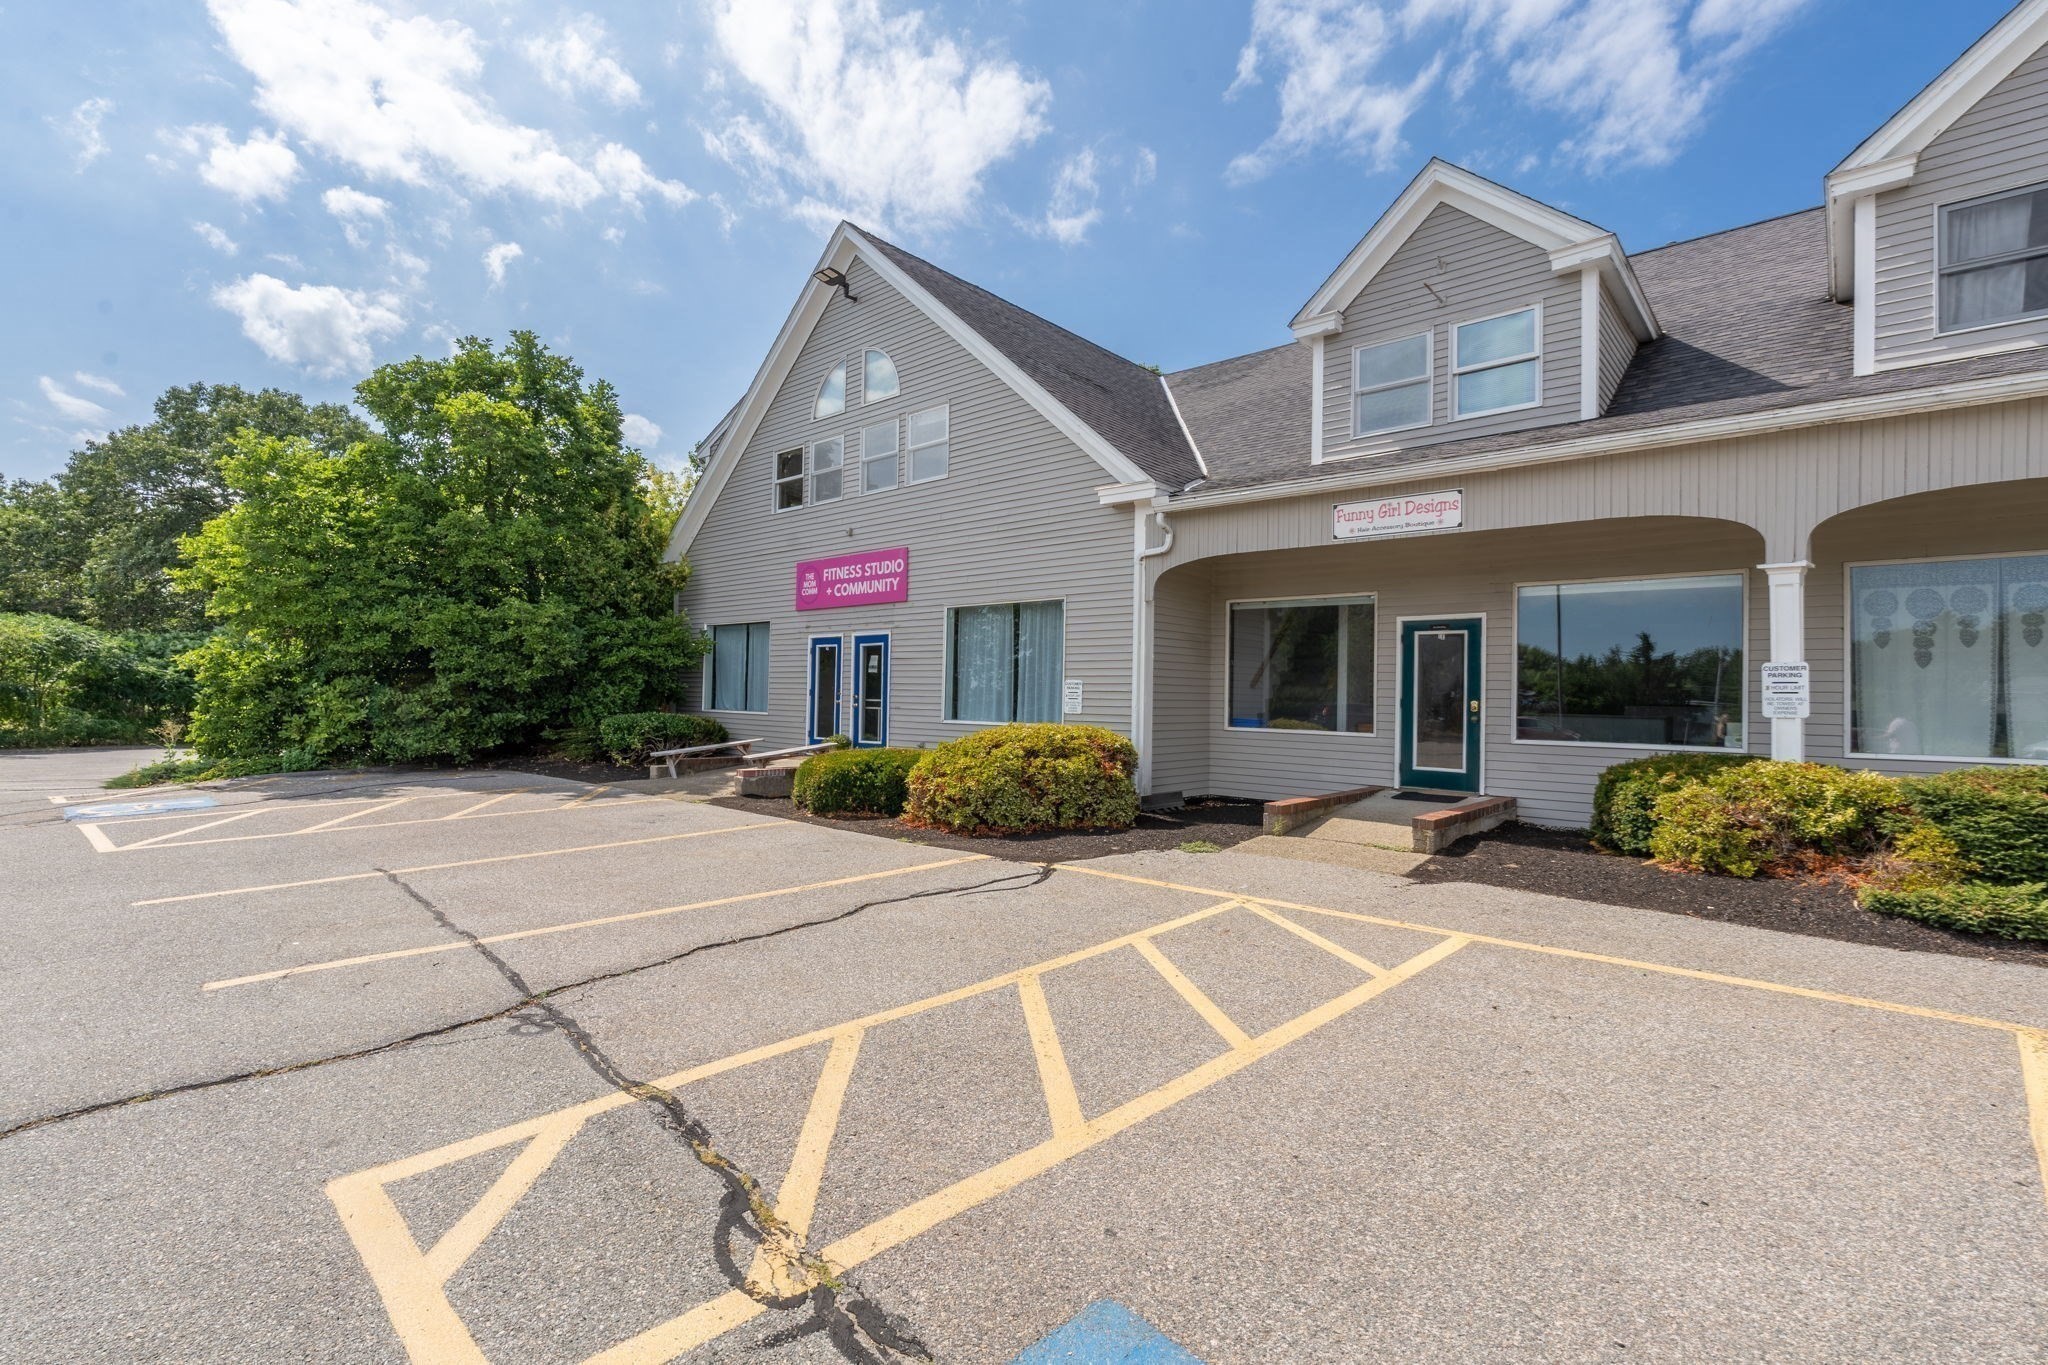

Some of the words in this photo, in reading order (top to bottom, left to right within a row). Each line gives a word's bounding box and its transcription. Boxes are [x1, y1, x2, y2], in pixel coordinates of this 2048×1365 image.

[1336, 508, 1374, 523] Funny
[1378, 502, 1400, 518] Girl
[1404, 498, 1459, 517] Designs
[1371, 524, 1403, 532] Accessory
[1404, 520, 1435, 529] Boutique
[805, 572, 815, 580] THE
[823, 564, 862, 581] FITNESS
[864, 559, 904, 576] STUDIO
[801, 587, 818, 596] COMM
[834, 577, 900, 597] COMMUNITY
